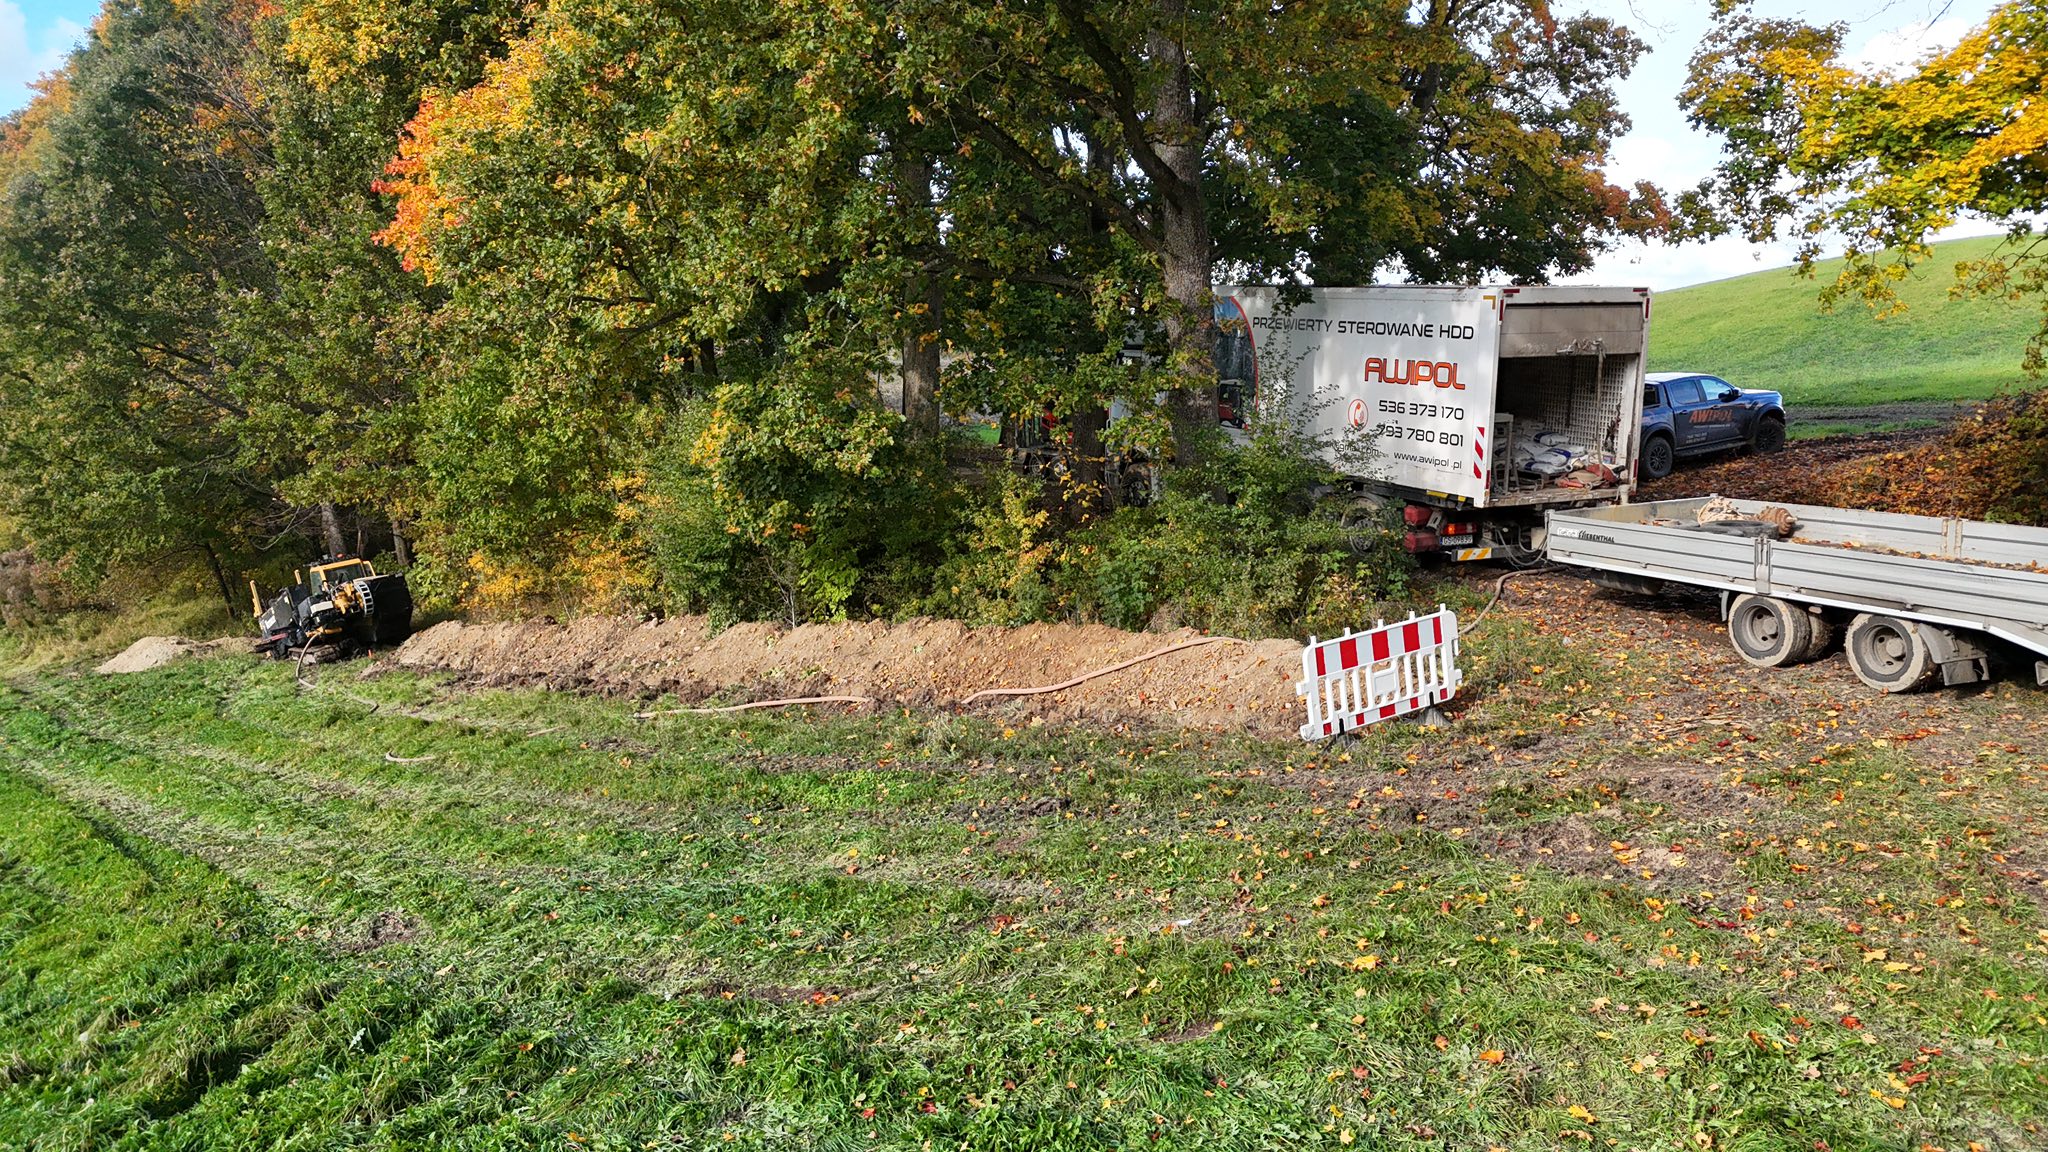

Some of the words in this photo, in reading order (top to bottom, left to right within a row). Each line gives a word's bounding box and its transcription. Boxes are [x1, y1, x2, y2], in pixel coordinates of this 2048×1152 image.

[1252, 317, 1333, 332] PRZEWIERTY
[1337, 320, 1434, 338] STEROWANE
[1439, 324, 1474, 340] HDD
[1364, 357, 1466, 391] AWIPOL
[1378, 399, 1406, 414] 536
[1409, 402, 1437, 417] 373
[1440, 405, 1464, 421] 170
[1378, 423, 1403, 439] 793
[1406, 427, 1435, 443] 780
[1438, 432, 1464, 447] 801
